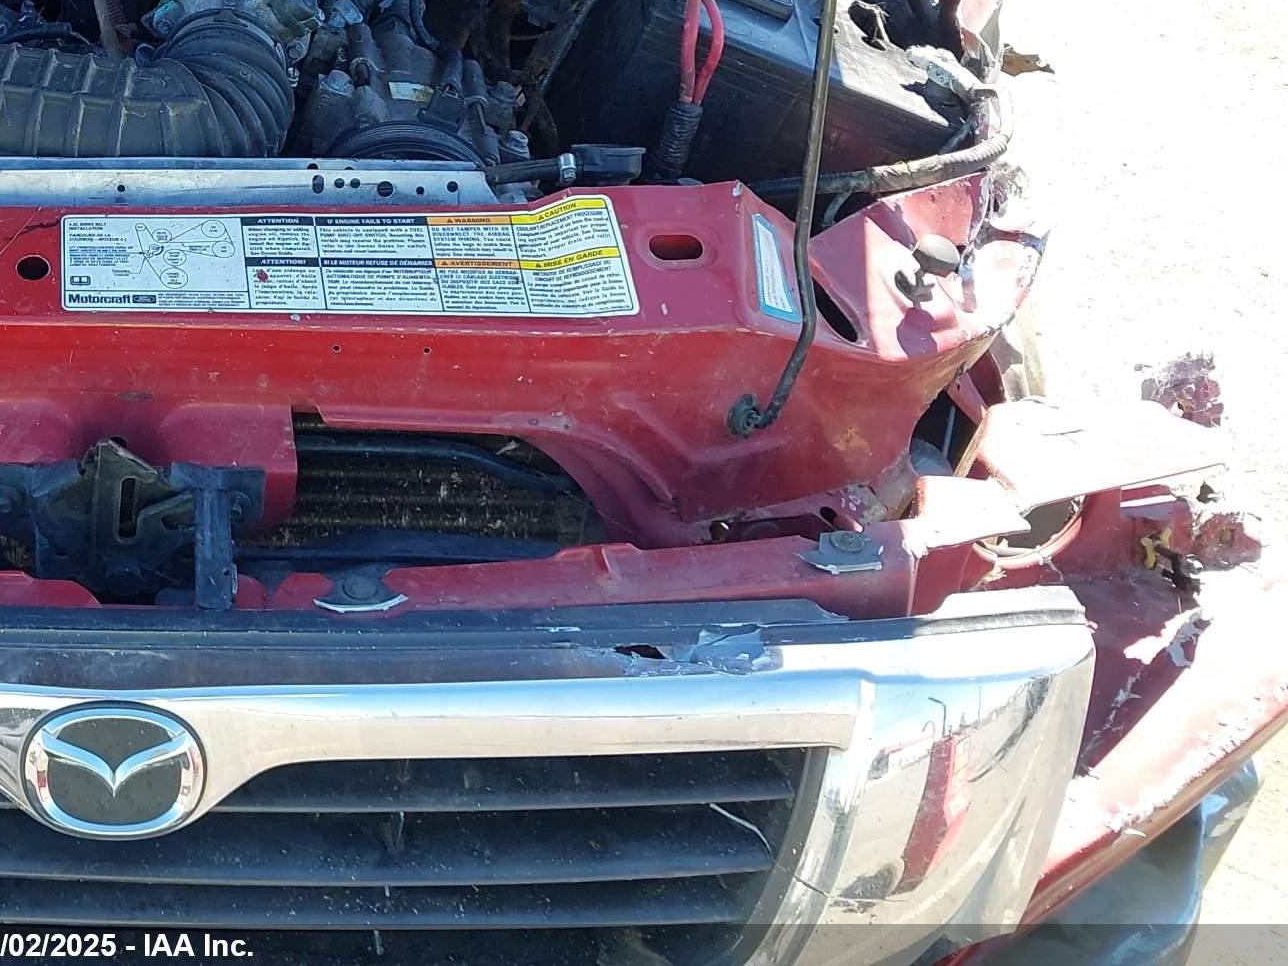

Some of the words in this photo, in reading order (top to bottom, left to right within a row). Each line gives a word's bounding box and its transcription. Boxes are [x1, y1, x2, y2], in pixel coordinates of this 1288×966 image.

[544, 202, 577, 218] CAUTION
[543, 259, 563, 268] MISE
[564, 256, 574, 264] EN
[576, 250, 603, 260] GARDE
[68, 294, 131, 304] Motorcraft
